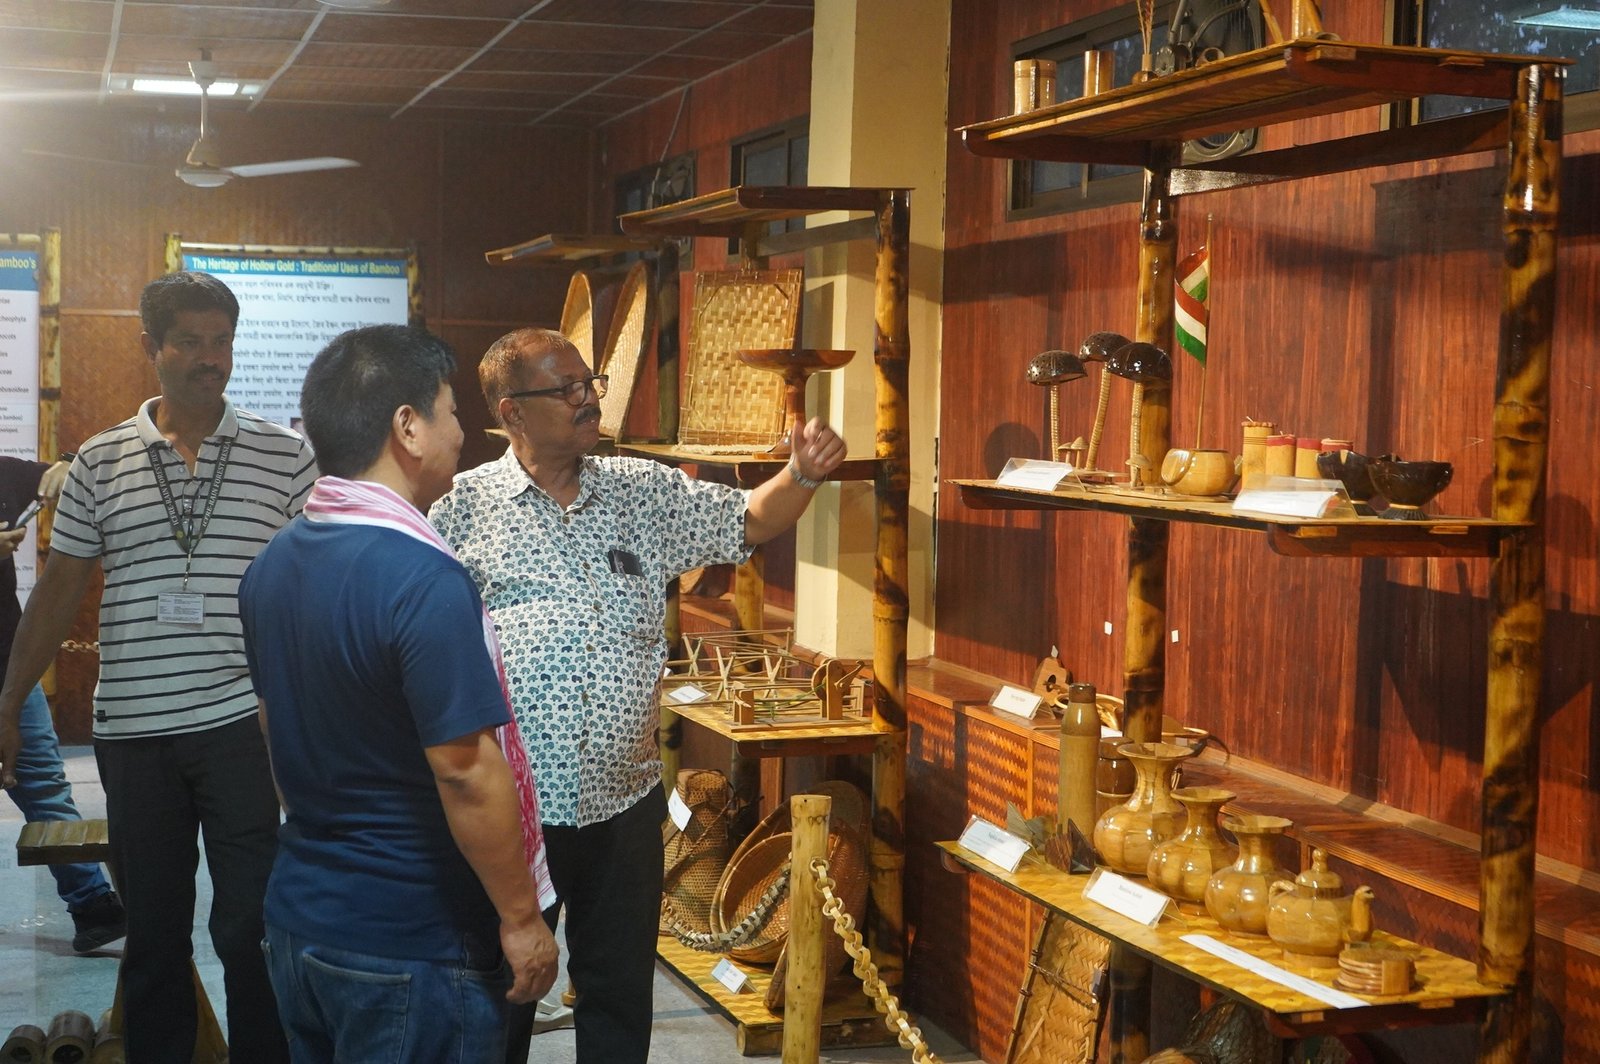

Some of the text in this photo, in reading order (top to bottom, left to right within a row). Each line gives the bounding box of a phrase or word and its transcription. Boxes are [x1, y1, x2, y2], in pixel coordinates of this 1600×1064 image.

[192, 257, 207, 269] The
[208, 257, 239, 273] Heritage
[240, 258, 249, 271] of
[250, 259, 275, 272] Hollow
[276, 259, 295, 272] Gold
[301, 260, 339, 273] Traditional
[340, 261, 358, 274] Uses
[360, 262, 368, 274] of
[369, 262, 400, 274] Bamboo
[213, 462, 224, 487] FOREST
